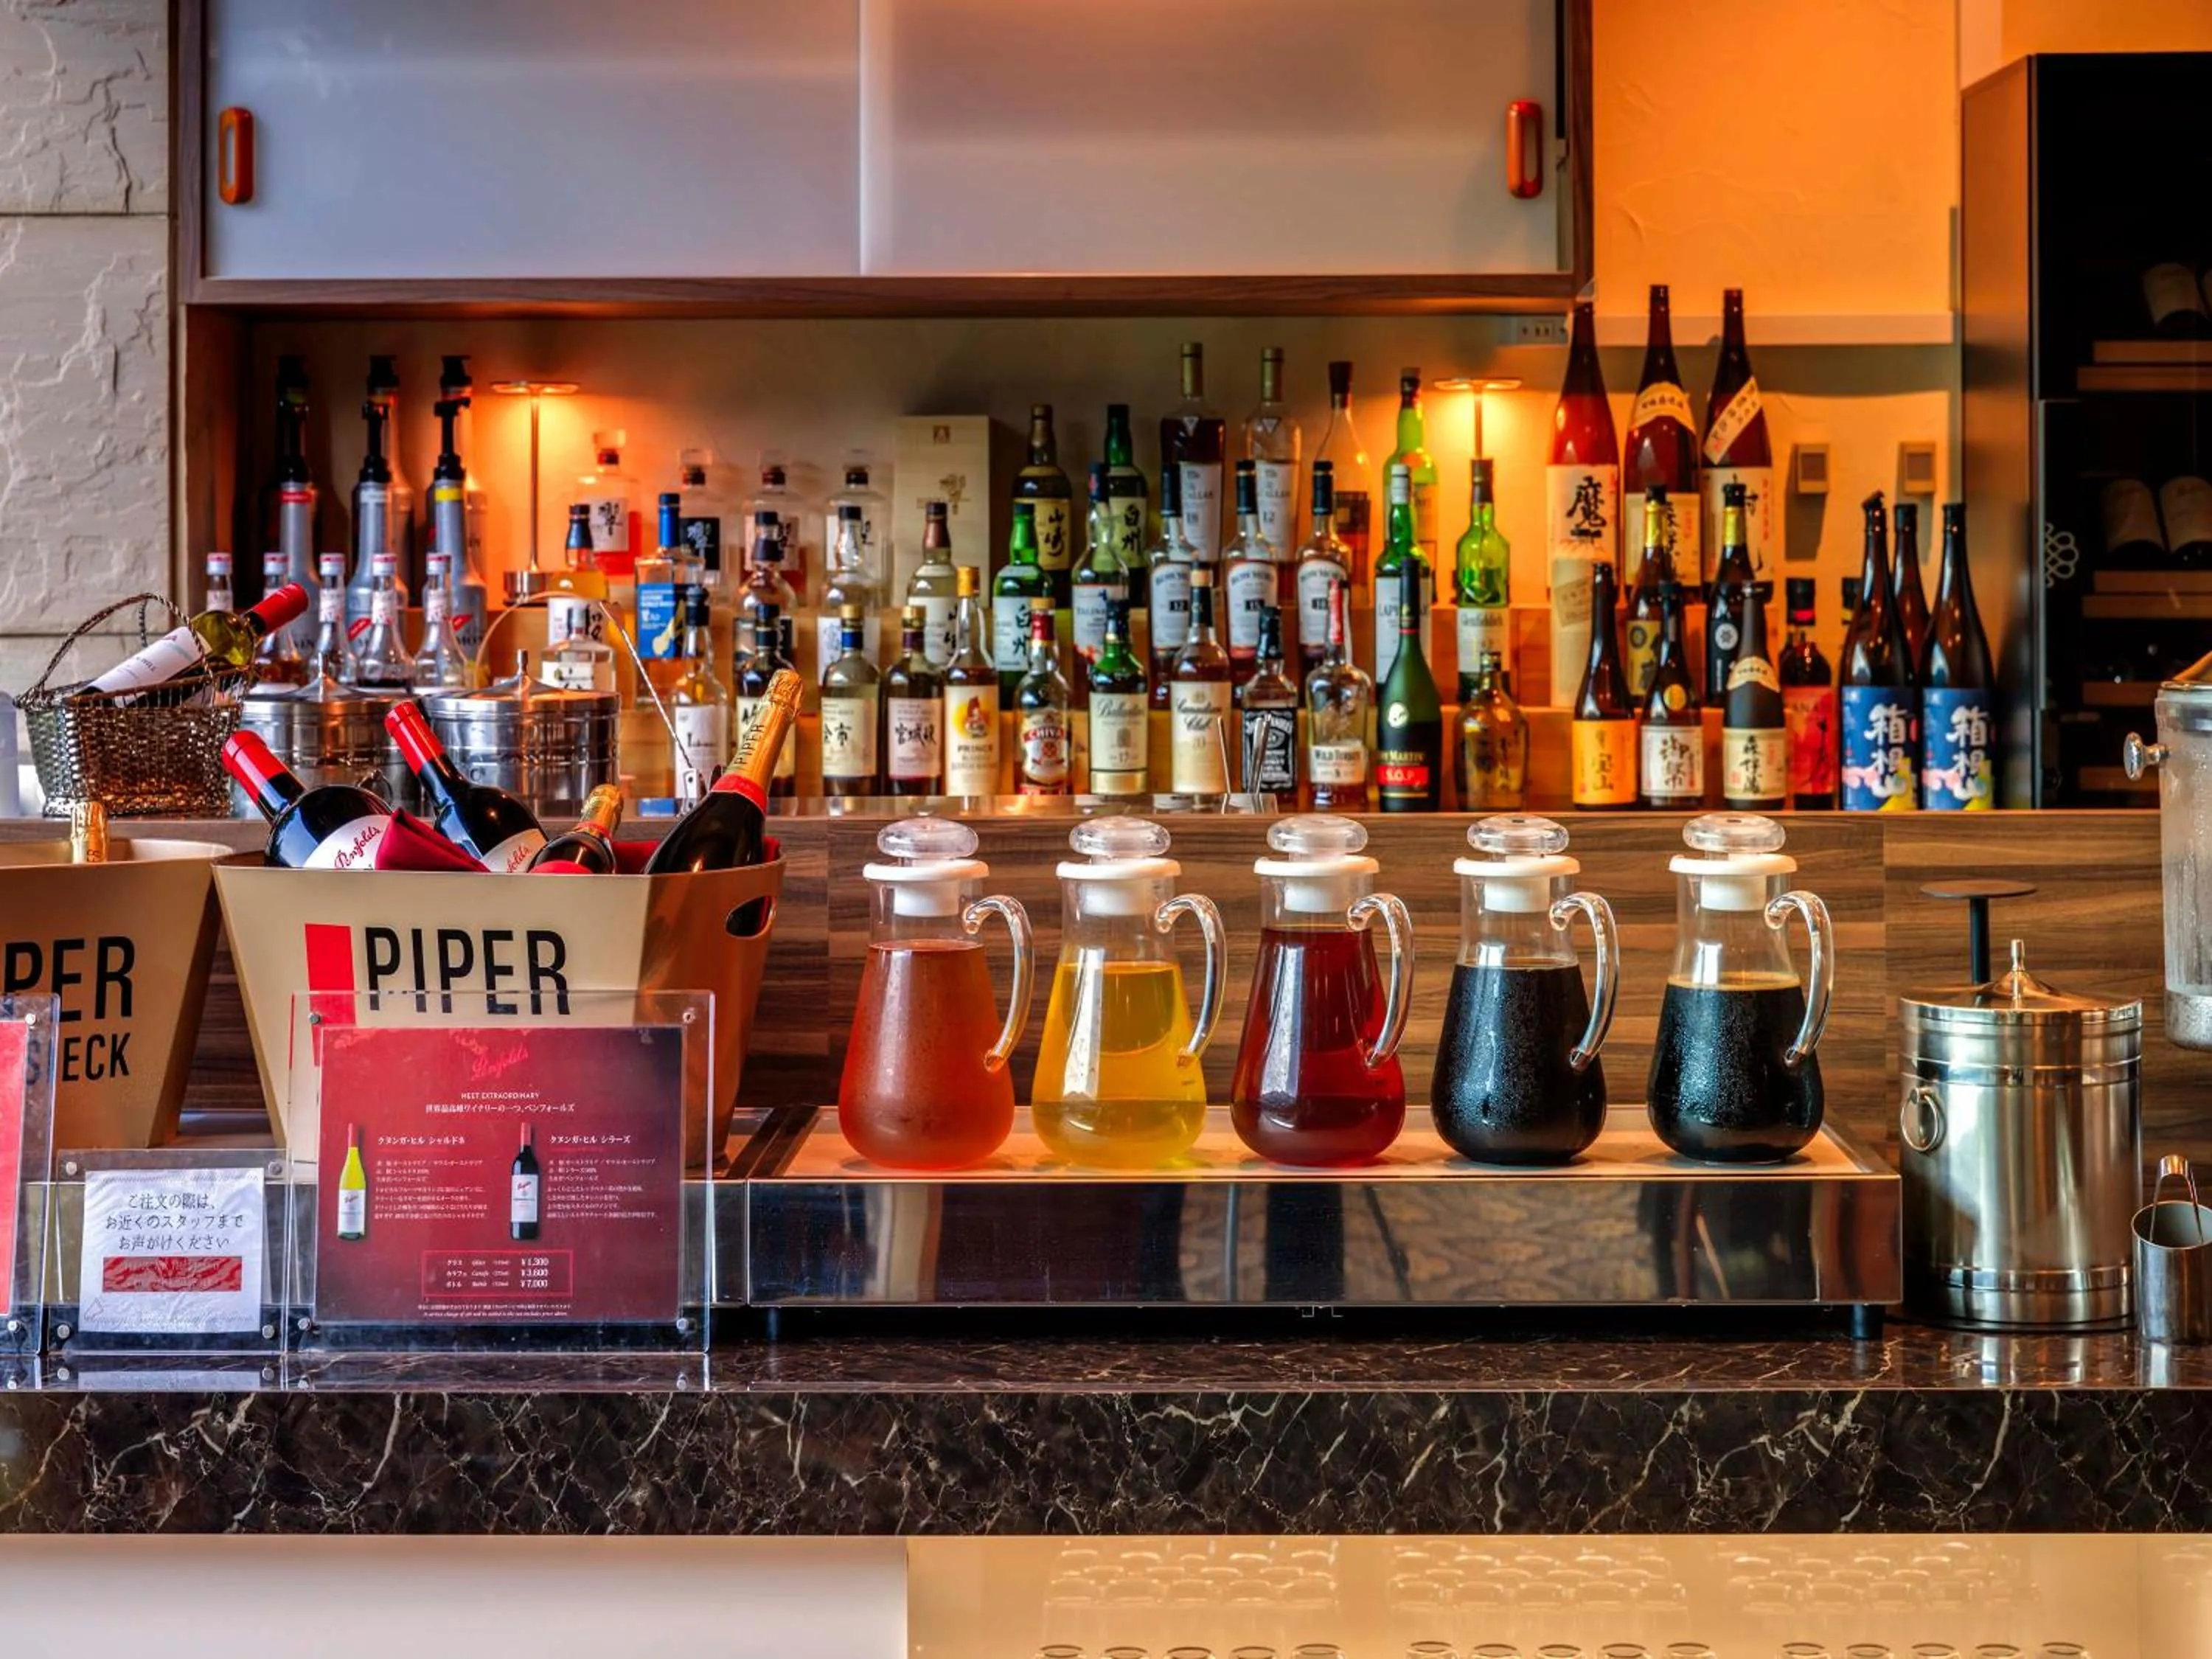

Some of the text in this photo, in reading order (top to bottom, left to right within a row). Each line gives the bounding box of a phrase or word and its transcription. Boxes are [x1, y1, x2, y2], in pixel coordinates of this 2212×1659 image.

[365, 927, 571, 1015] PIPER
[128, 1192, 216, 1210] ご注文の際は、
[105, 1214, 244, 1231] お近くのスタッフまで
[119, 1235, 230, 1251] お声がけください
